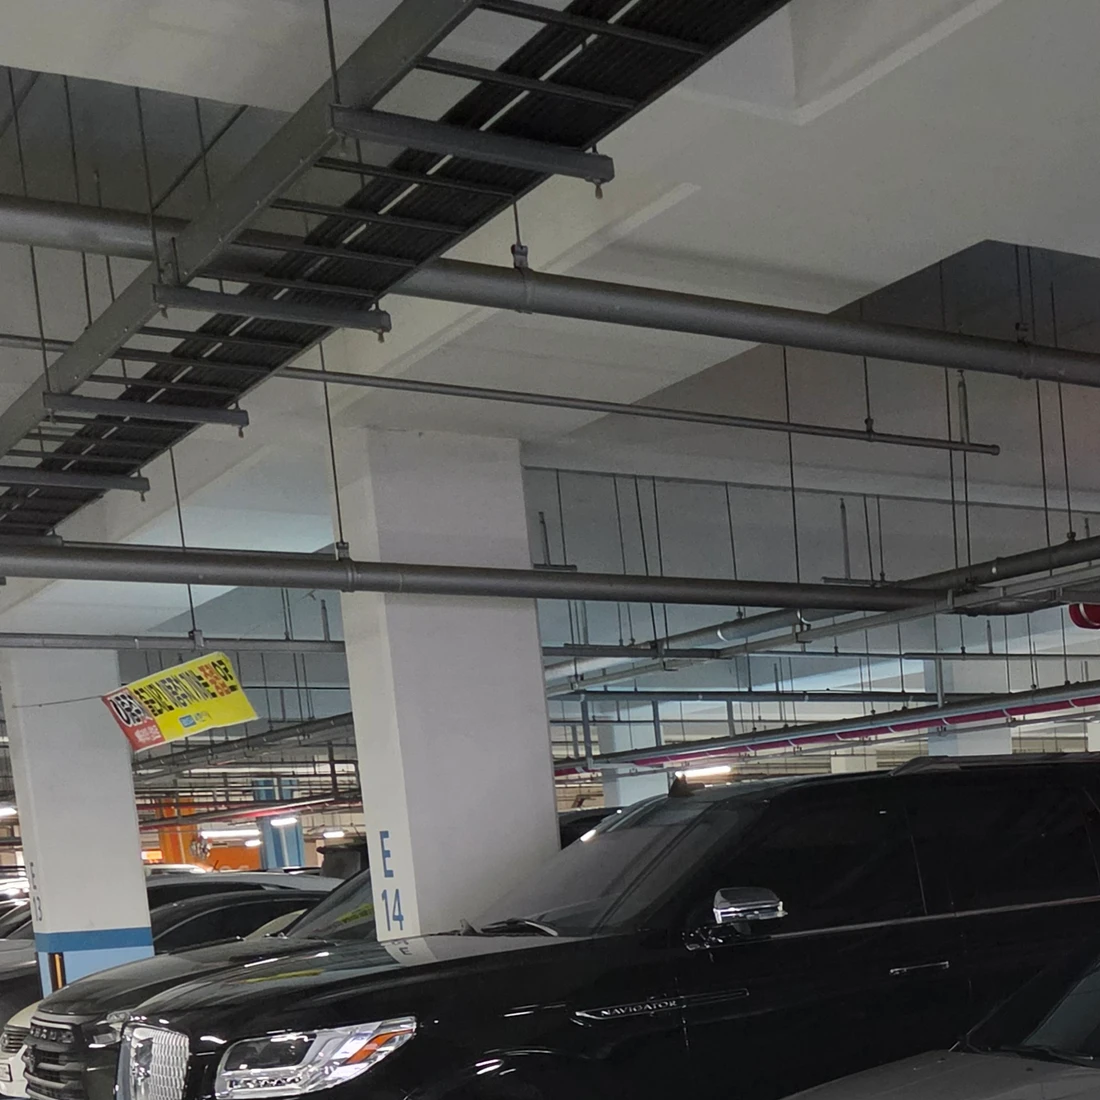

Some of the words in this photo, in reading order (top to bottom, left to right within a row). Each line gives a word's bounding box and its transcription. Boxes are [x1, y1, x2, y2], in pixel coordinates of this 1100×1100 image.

[380, 830, 394, 878] E
[29, 862, 37, 890] E
[381, 888, 404, 931] 14
[601, 1000, 677, 1016] NAVIGATOR
